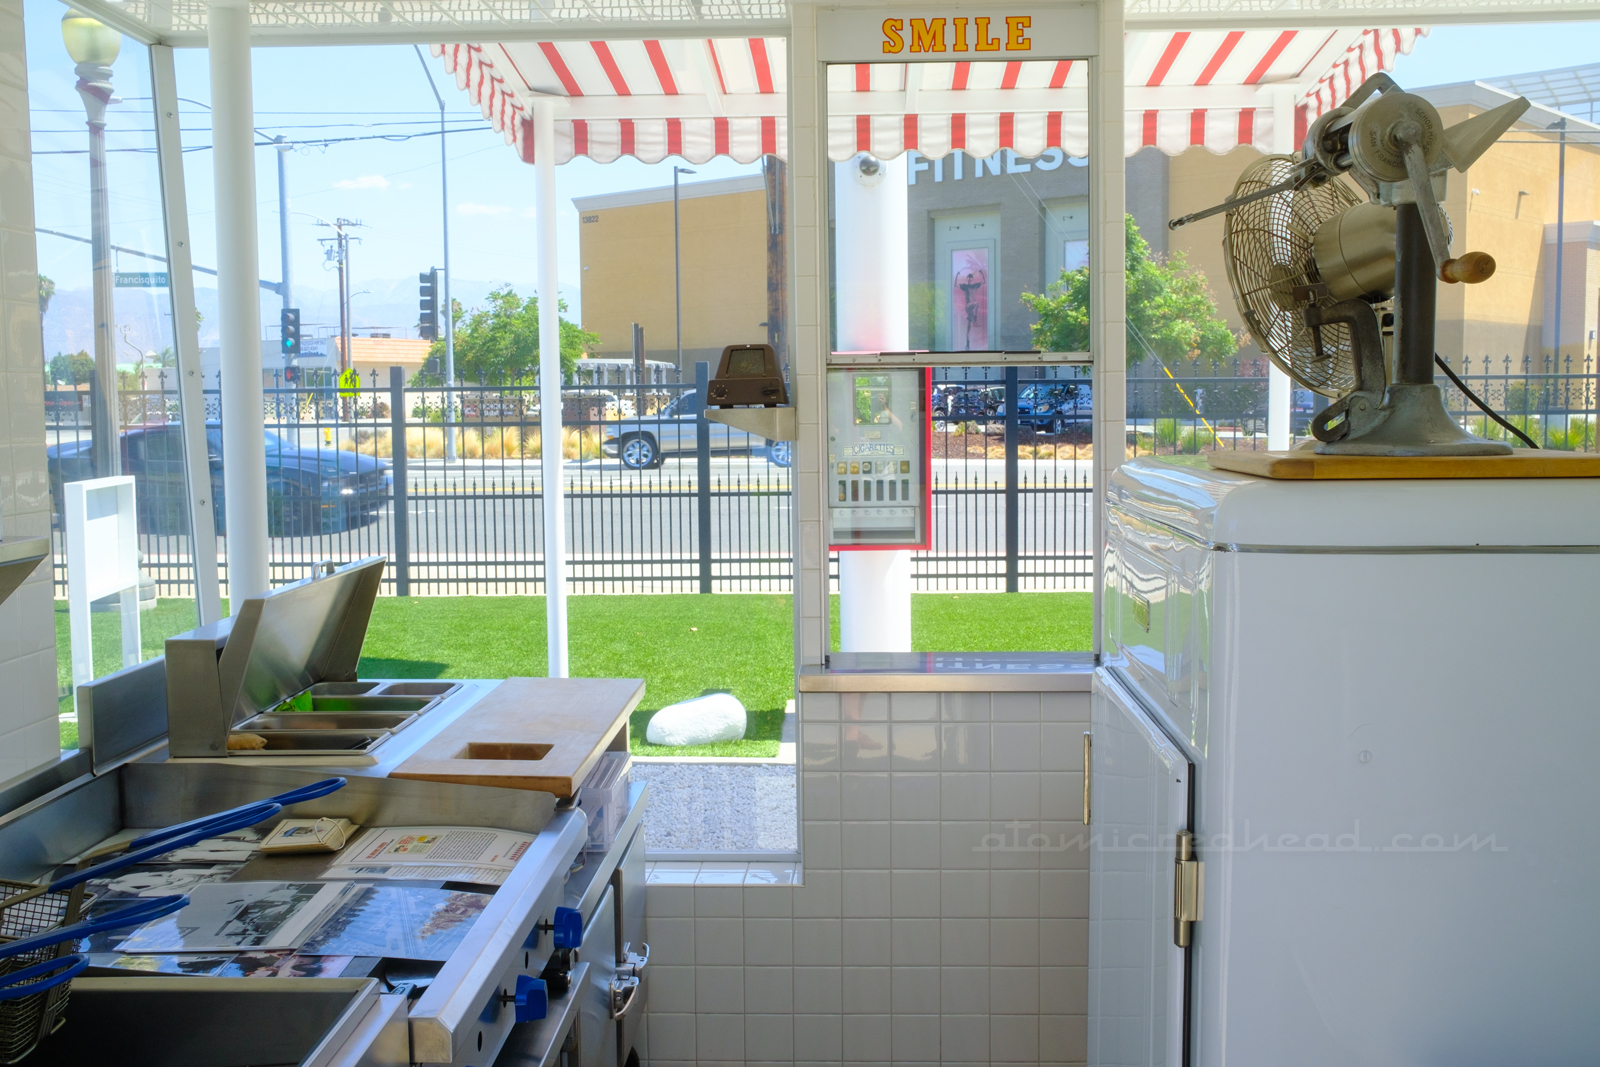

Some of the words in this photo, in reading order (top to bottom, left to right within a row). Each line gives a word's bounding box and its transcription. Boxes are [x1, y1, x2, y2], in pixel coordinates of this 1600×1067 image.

[882, 16, 1032, 54] SMILE
[1415, 108, 1433, 130] SCHOR
[907, 147, 1089, 186] FITNES
[115, 275, 166, 285] Francisquito
[852, 443, 895, 456] CIGARETTES
